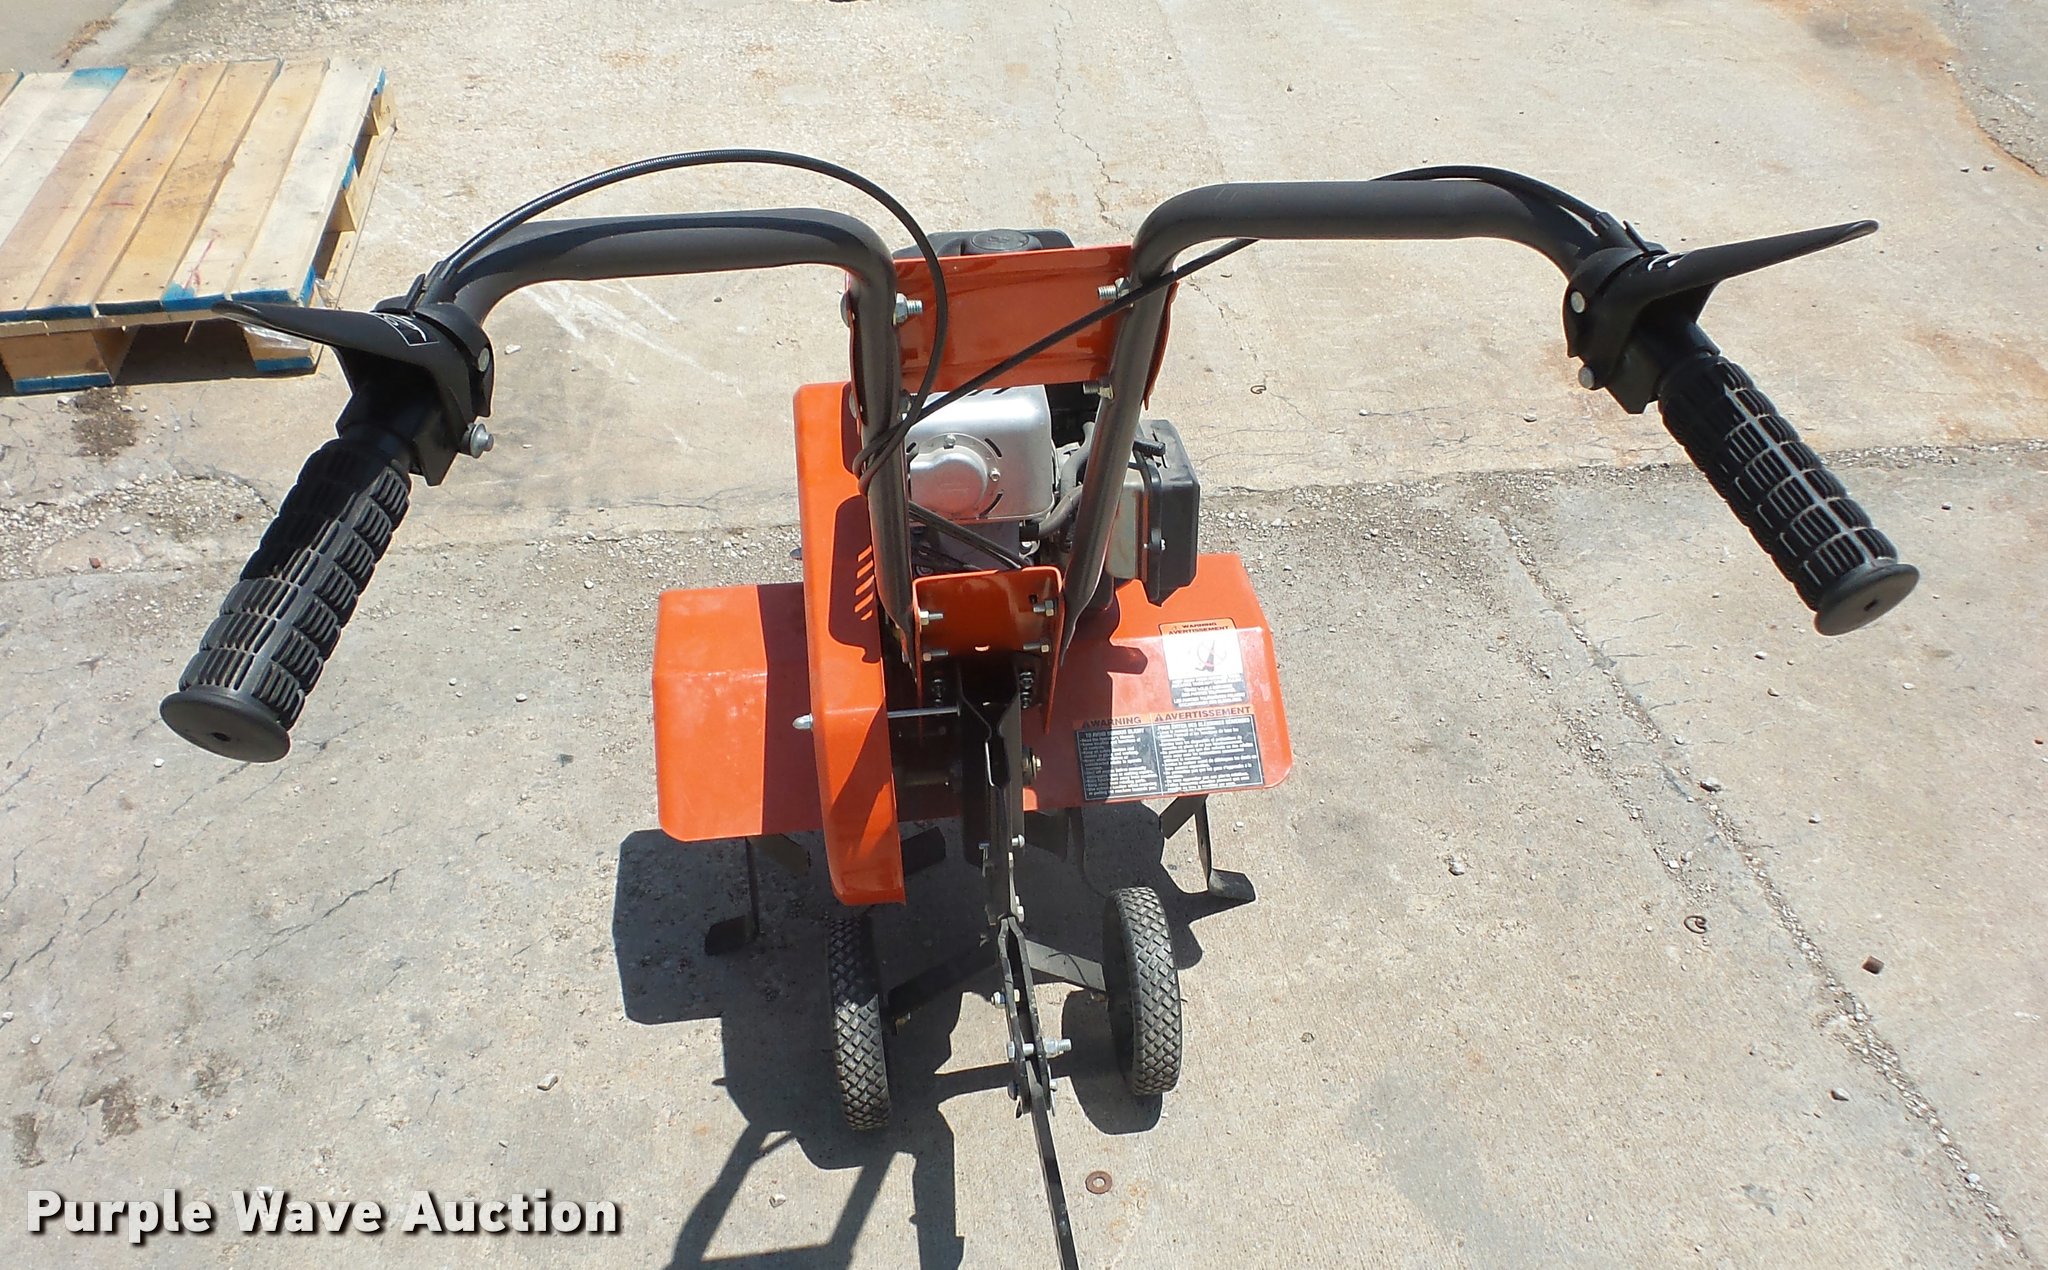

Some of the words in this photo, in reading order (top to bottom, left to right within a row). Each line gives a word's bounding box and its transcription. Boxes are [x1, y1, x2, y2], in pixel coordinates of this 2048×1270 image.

[1168, 626, 1229, 635] AVERTISSEMENT
[1165, 706, 1251, 721] AVERTISSEMENT
[1090, 716, 1142, 727] WARNING
